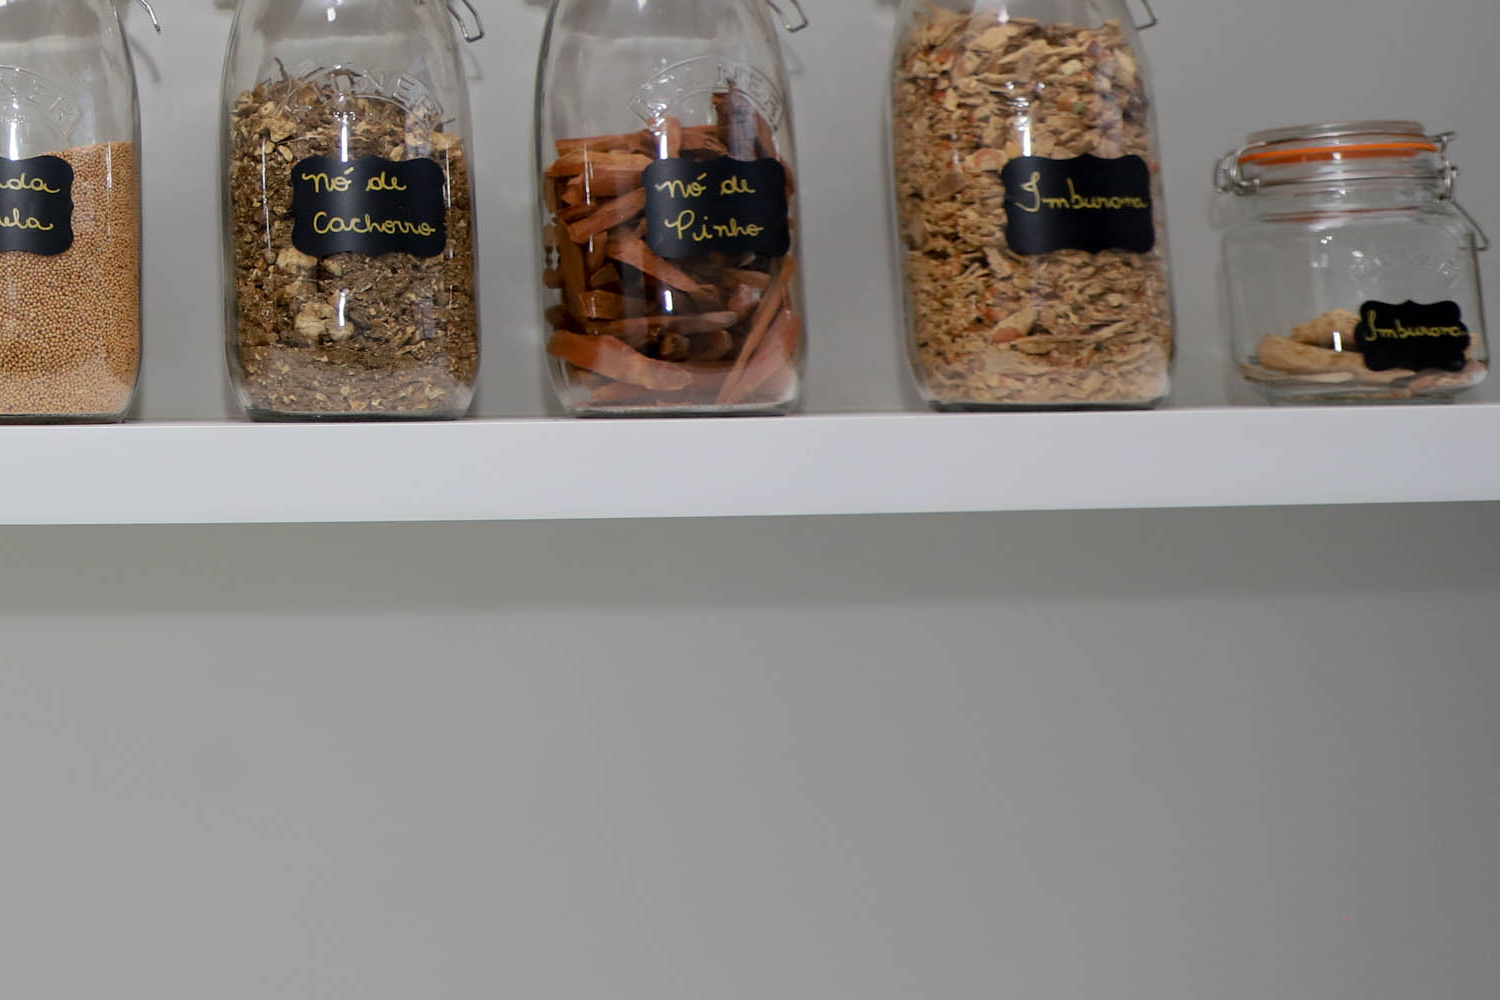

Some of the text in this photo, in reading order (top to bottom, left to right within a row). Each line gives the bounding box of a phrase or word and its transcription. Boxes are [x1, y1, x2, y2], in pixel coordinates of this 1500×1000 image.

[365, 171, 407, 192] de
[719, 176, 756, 196] de
[313, 211, 436, 236] Cachorro
[664, 209, 764, 241] Pinho
